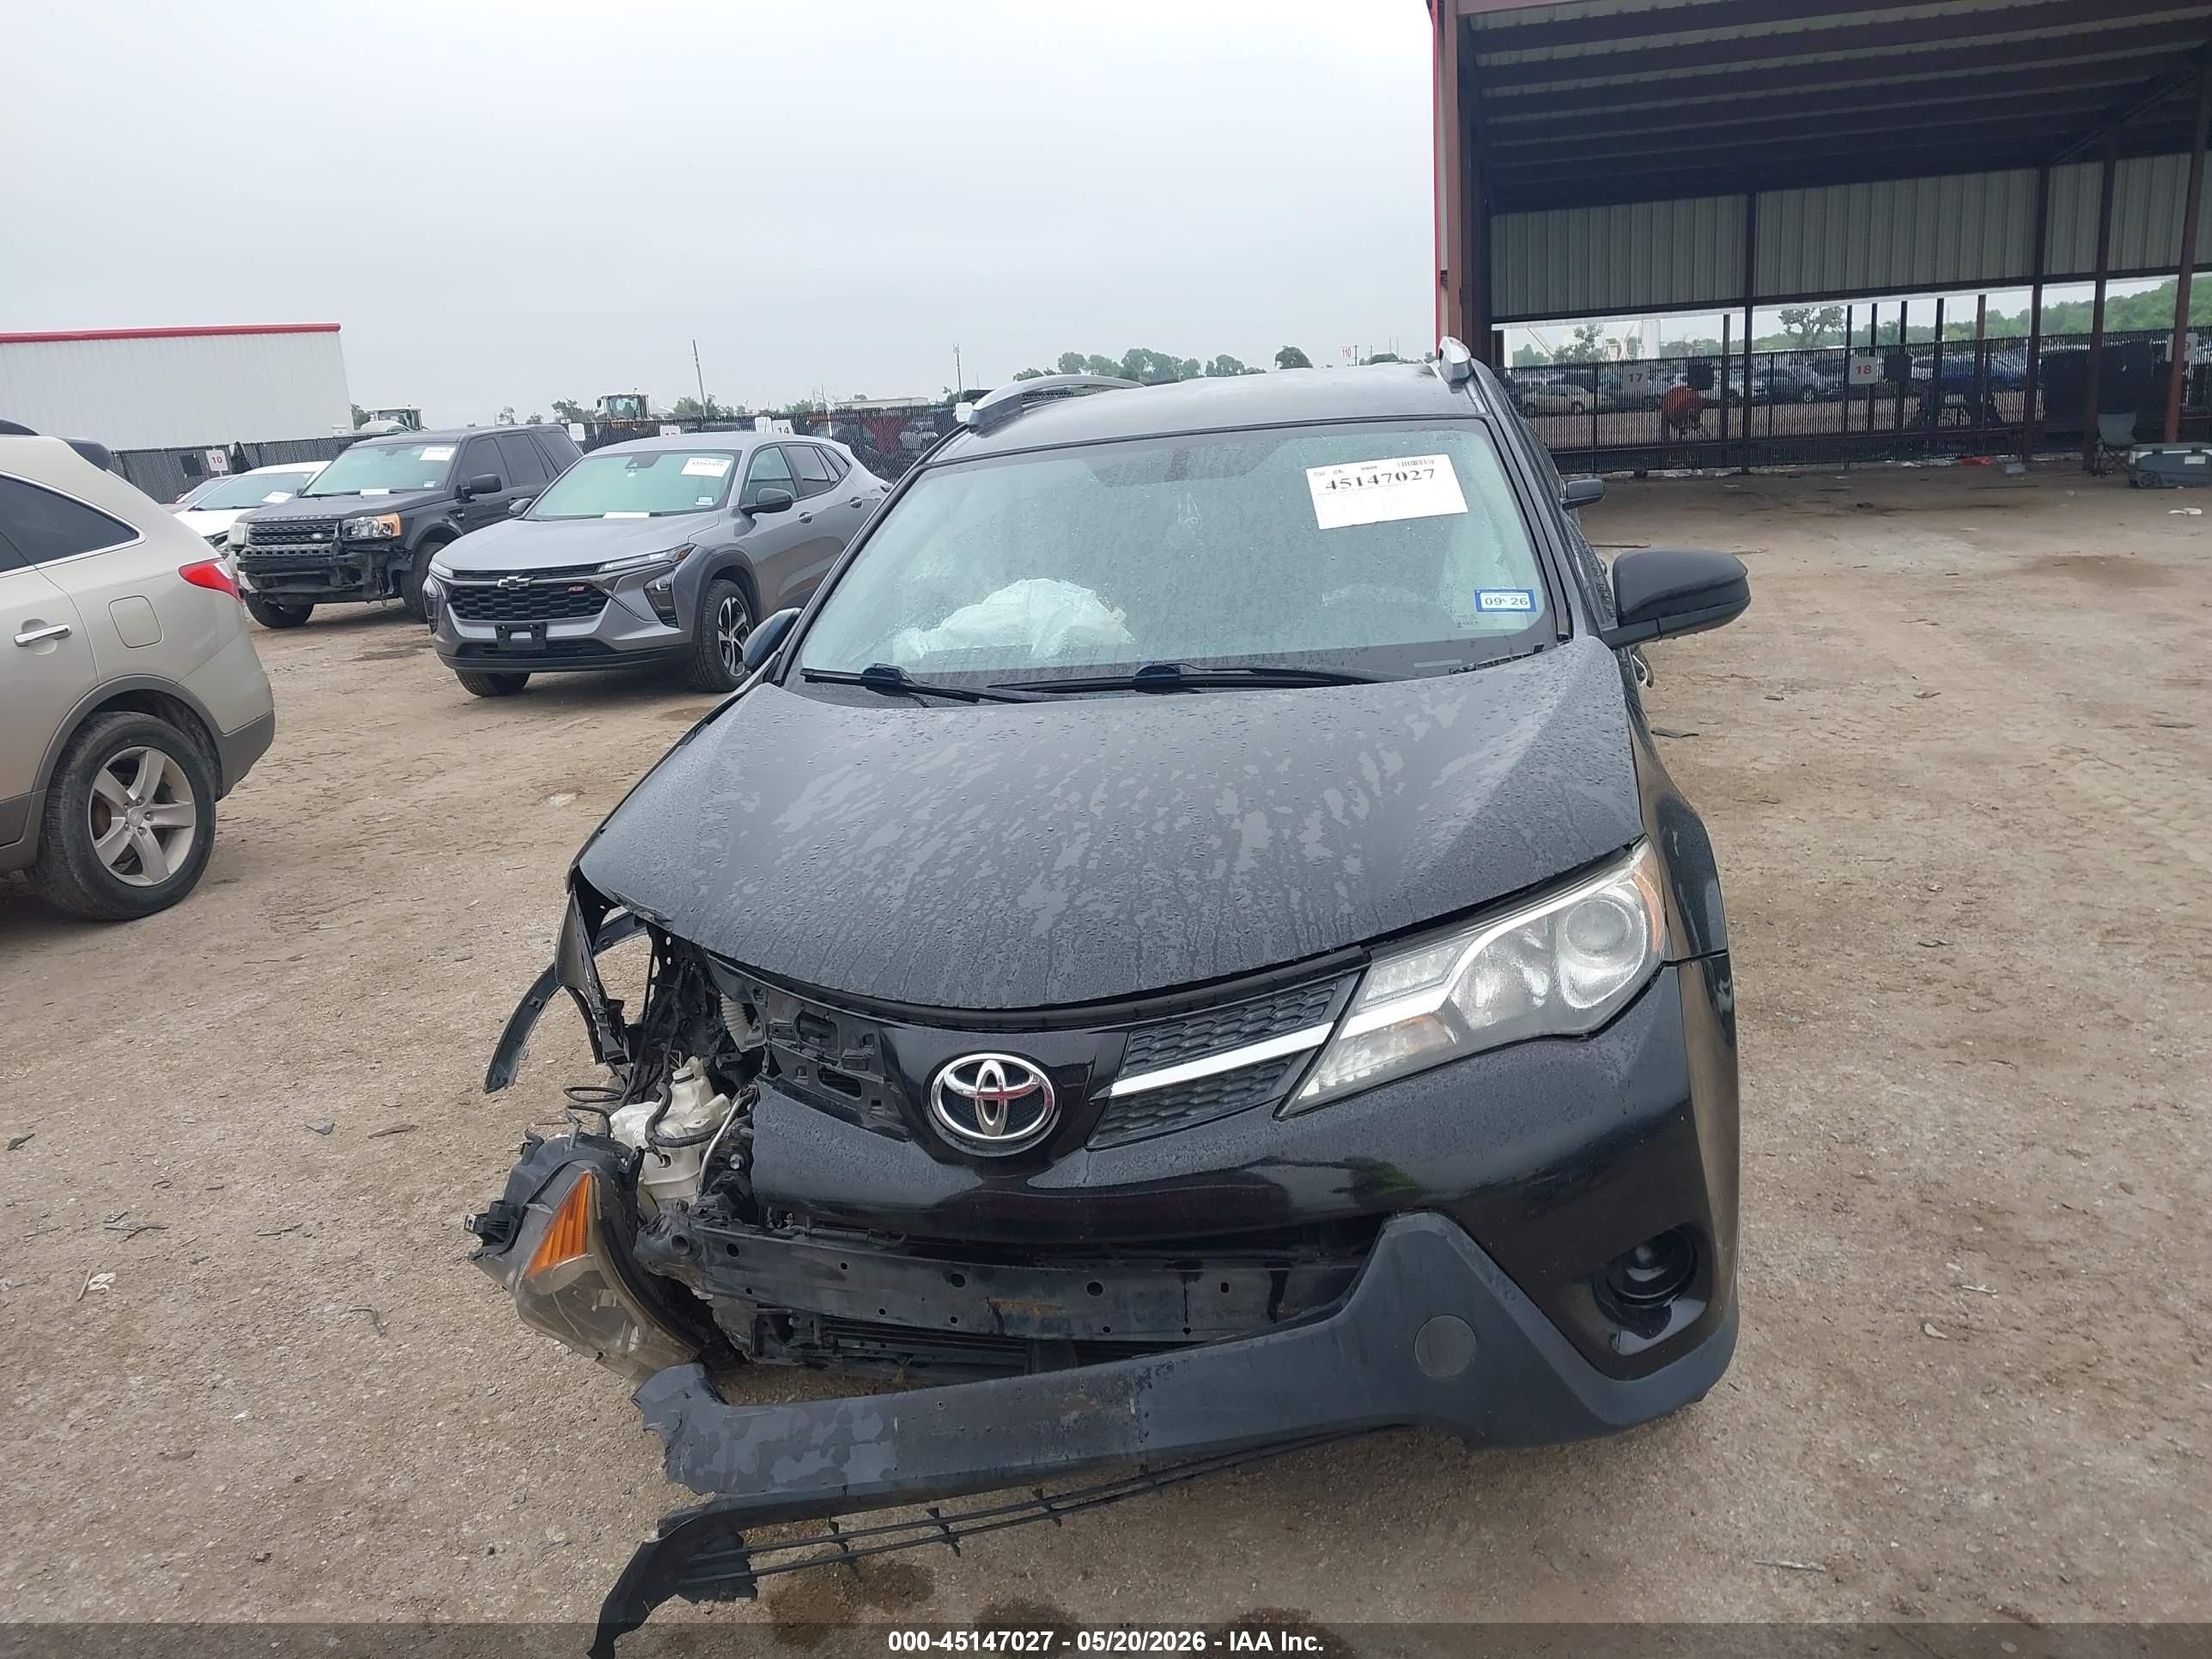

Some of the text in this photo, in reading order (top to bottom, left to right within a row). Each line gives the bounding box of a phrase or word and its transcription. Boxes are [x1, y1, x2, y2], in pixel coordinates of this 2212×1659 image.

[1856, 364, 1872, 375] 18
[1628, 373, 1643, 383] 17
[778, 426, 790, 434] 14
[1325, 468, 1435, 490] 45147027
[1485, 597, 1528, 605] 09 26
